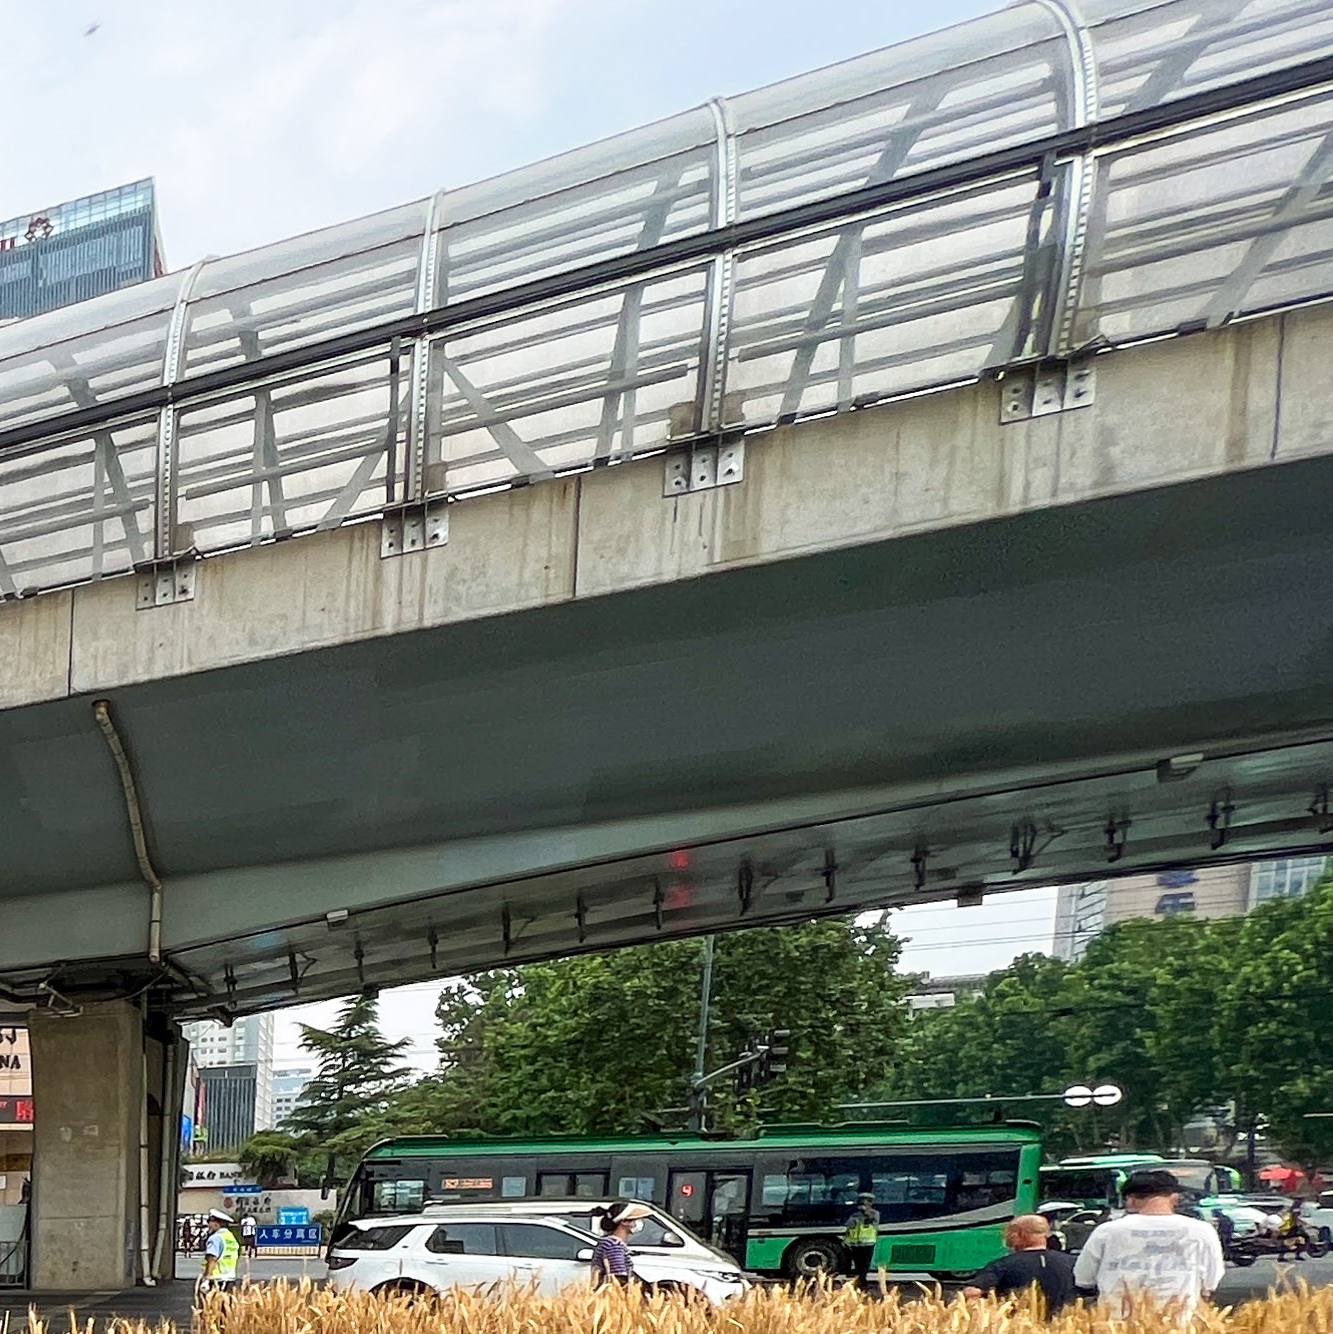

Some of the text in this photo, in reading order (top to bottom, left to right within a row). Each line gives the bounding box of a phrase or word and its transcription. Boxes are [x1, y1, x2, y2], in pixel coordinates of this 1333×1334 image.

[259, 1228, 318, 1240] 人车分离区
